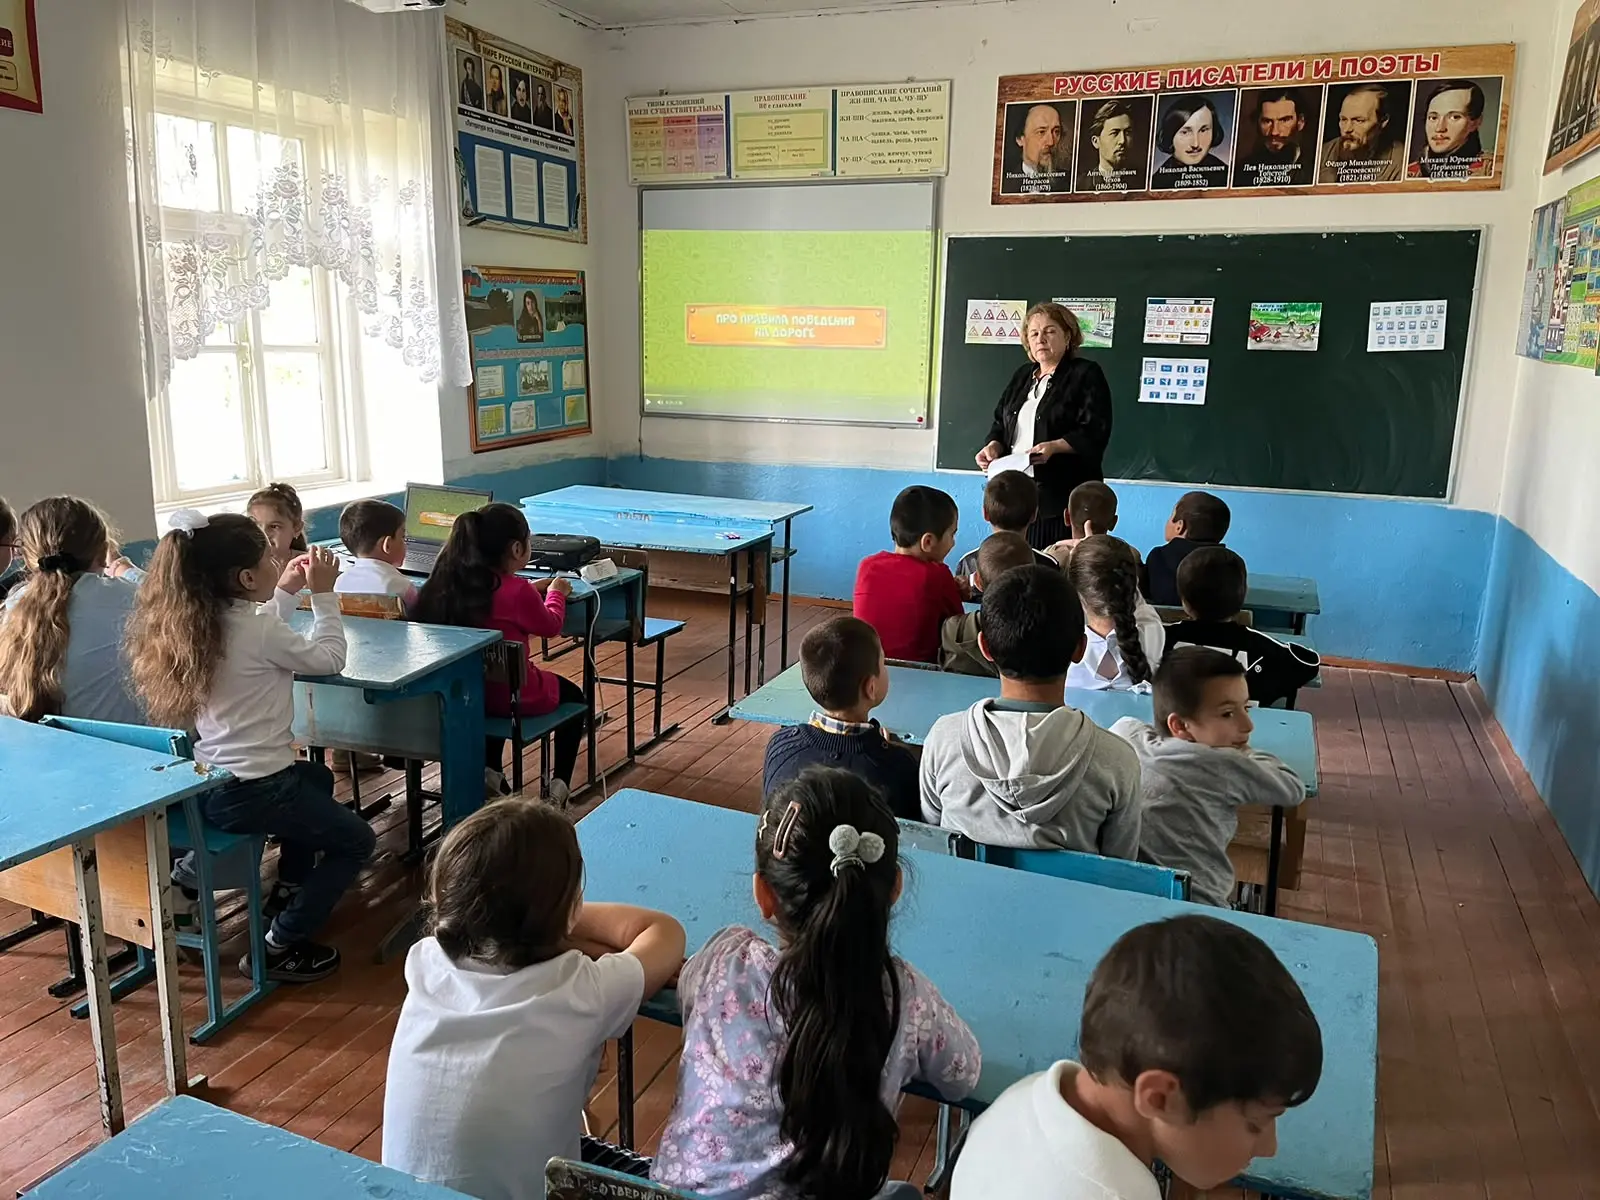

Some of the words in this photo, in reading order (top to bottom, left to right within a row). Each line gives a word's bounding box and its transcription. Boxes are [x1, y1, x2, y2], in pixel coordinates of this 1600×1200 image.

[482, 46, 498, 60] МИРЕ
[499, 52, 522, 68] РУССКОЙ
[522, 61, 555, 79] ЛИТЕРАТУРЫ
[1053, 70, 1162, 96] РУССКИЕ
[1166, 60, 1306, 89] ПИСАТЕЛИ
[1312, 58, 1333, 80] И
[1339, 52, 1441, 77] ПОЭТЫ
[840, 87, 898, 97] ПРАВОПИСАНИЕ
[898, 85, 942, 95] СОЧЕТАНИЙ
[666, 98, 705, 106] СКЛОНЕНИЙ
[753, 93, 807, 102] ПРАВОПИСАНИЕ
[650, 105, 723, 115] СУЩЕСТВИТЕЛЬНЫХ
[1325, 159, 1348, 169] Фёдор
[1348, 158, 1393, 167] Михайлович
[1419, 156, 1449, 164] Михаил
[1449, 155, 1482, 164] Юрьевич
[1160, 165, 1187, 174] Николай
[1188, 165, 1225, 173] Васильевич
[1243, 164, 1257, 172] Лев
[1258, 163, 1302, 172] Николаевич
[1336, 166, 1381, 175] Достоевский
[1430, 163, 1469, 172] Лермонтов
[1108, 169, 1137, 177] авлович
[1258, 170, 1287, 178] Толстой
[1339, 173, 1377, 182] (1821-1881)
[1430, 170, 1468, 178] (1814-1841)
[1022, 178, 1050, 186] Некрасов
[1174, 179, 1209, 187] (1809-1852)
[1253, 175, 1291, 185] (1828-1910)
[1095, 182, 1127, 191] (1860-1904)
[716, 313, 738, 324] ПРО
[740, 313, 789, 325] ПРАВИЛА
[791, 314, 856, 326] ПОВЕДЕНИЯ
[754, 327, 770, 338] НА
[772, 327, 816, 338] ДОРОГЕ
